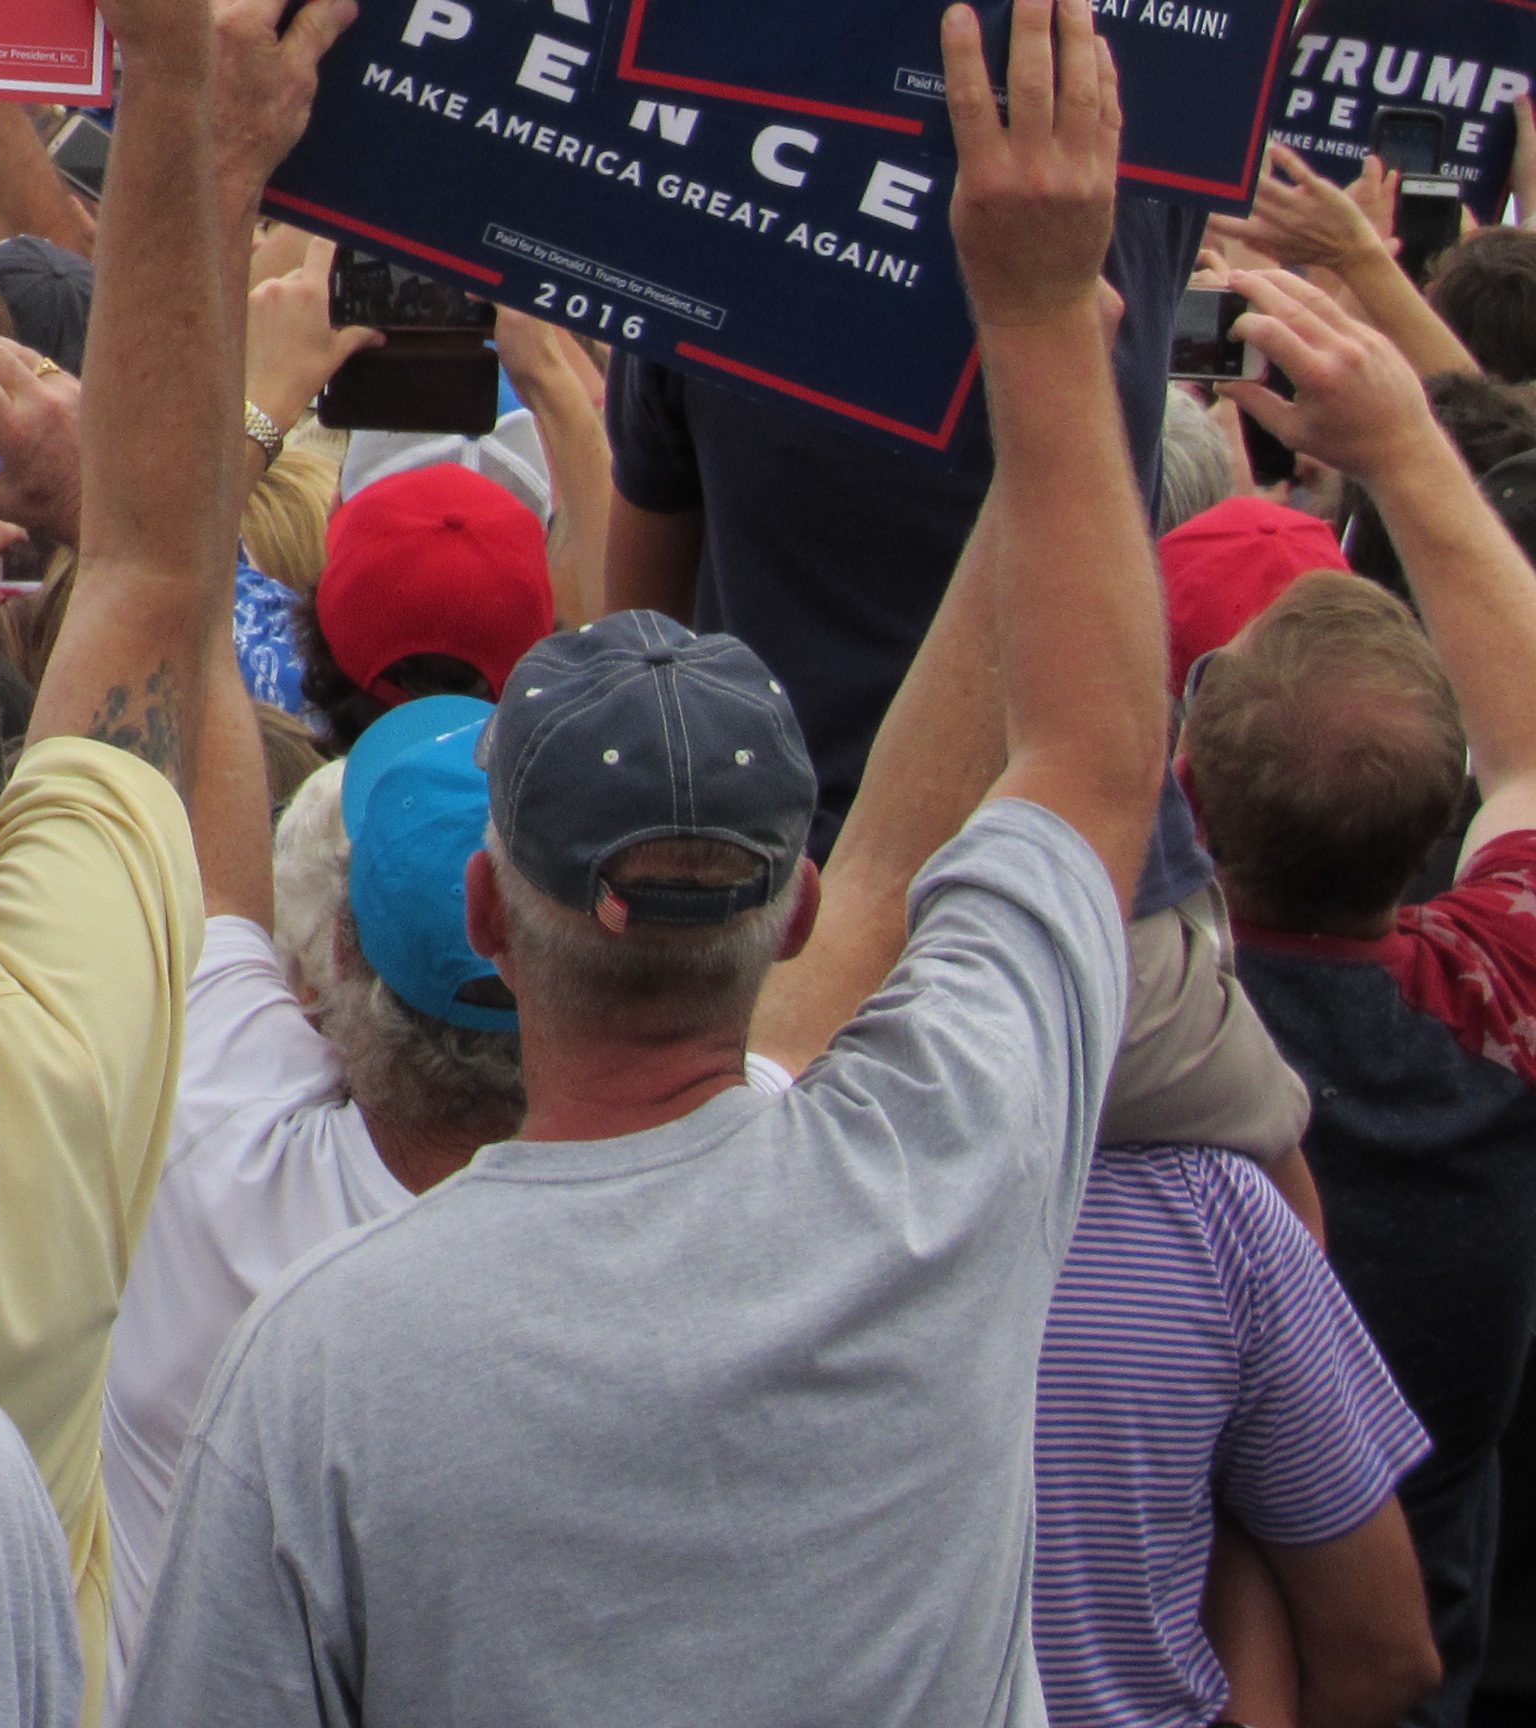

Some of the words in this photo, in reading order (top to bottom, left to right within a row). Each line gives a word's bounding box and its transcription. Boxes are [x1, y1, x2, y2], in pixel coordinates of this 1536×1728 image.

[1139, 0, 1229, 40] AGAIN!
[60, 51, 78, 63] Inc.
[907, 74, 932, 89] Paid
[933, 76, 945, 92] fo
[1290, 34, 1530, 114] TRUMP
[1284, 88, 1487, 154] PEE
[362, 63, 466, 120] MAKE
[476, 105, 644, 187] AMERICA
[657, 174, 780, 234] GREAT
[787, 220, 921, 289] AGAIN!
[1272, 129, 1311, 149] MAKE
[1314, 132, 1371, 160] AMERIC
[1440, 162, 1480, 181] GAIN!
[495, 231, 517, 248] Paid
[518, 239, 533, 252] for
[534, 245, 547, 260] by
[548, 251, 585, 273] Donald
[594, 267, 627, 288] Trump
[628, 278, 644, 293] for
[695, 305, 713, 321] Inc.
[533, 282, 645, 340] 2016
